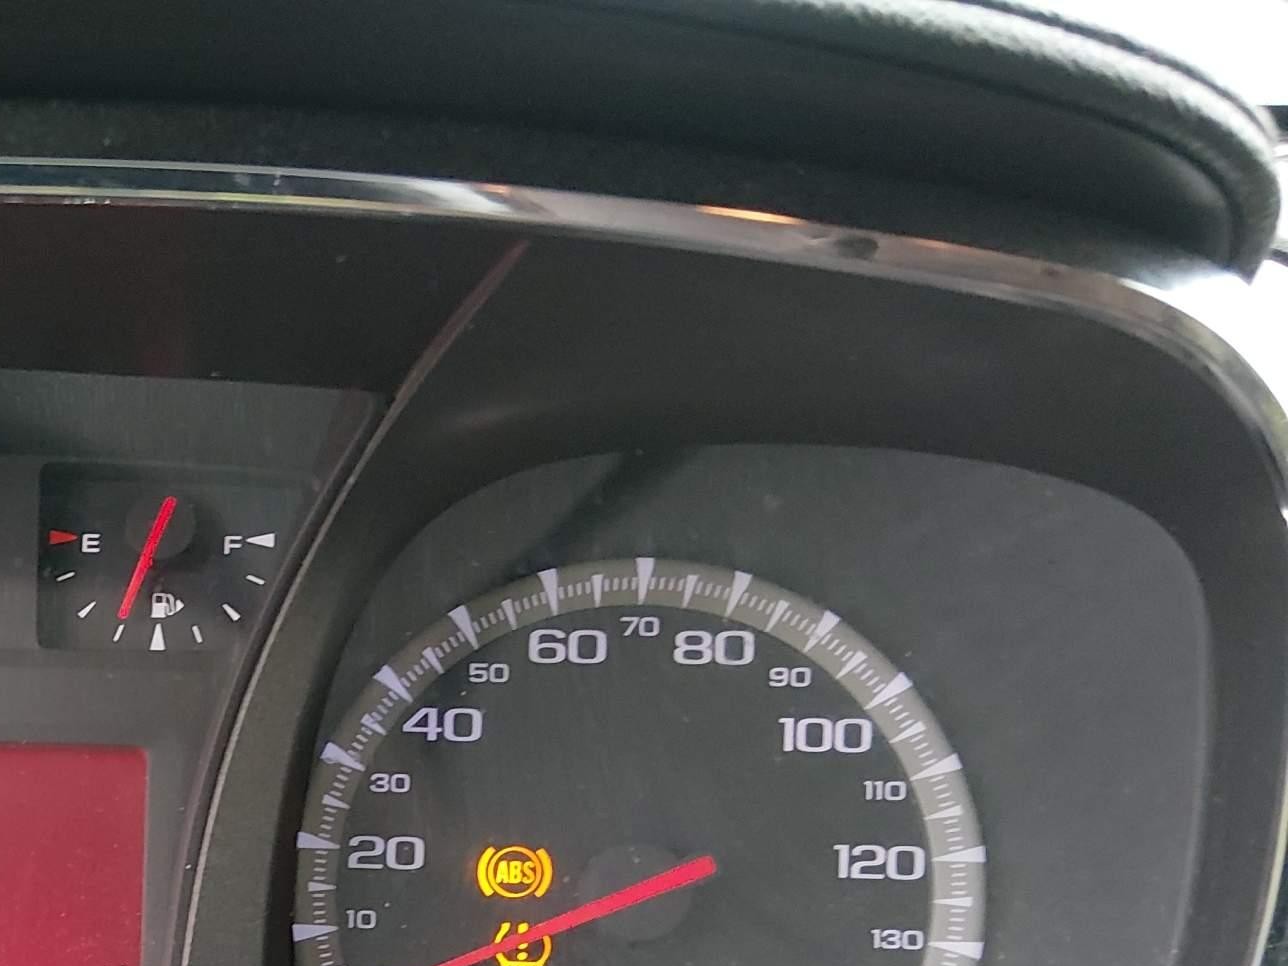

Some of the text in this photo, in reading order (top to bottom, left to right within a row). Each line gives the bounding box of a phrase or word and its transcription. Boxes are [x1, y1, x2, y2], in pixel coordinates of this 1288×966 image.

[81, 534, 101, 553] E
[223, 534, 242, 555] F
[620, 615, 660, 638] 70
[527, 629, 608, 665] 60
[672, 630, 755, 666] 80
[468, 662, 510, 684] 50
[768, 666, 812, 689] 90
[402, 707, 483, 743] 40
[778, 717, 873, 753] 100
[369, 773, 411, 795] 30
[863, 780, 907, 801] 110
[347, 836, 426, 871] 20
[833, 844, 926, 881] 120
[496, 861, 535, 885] ABS
[346, 909, 377, 930] 10
[870, 928, 925, 951] 130
